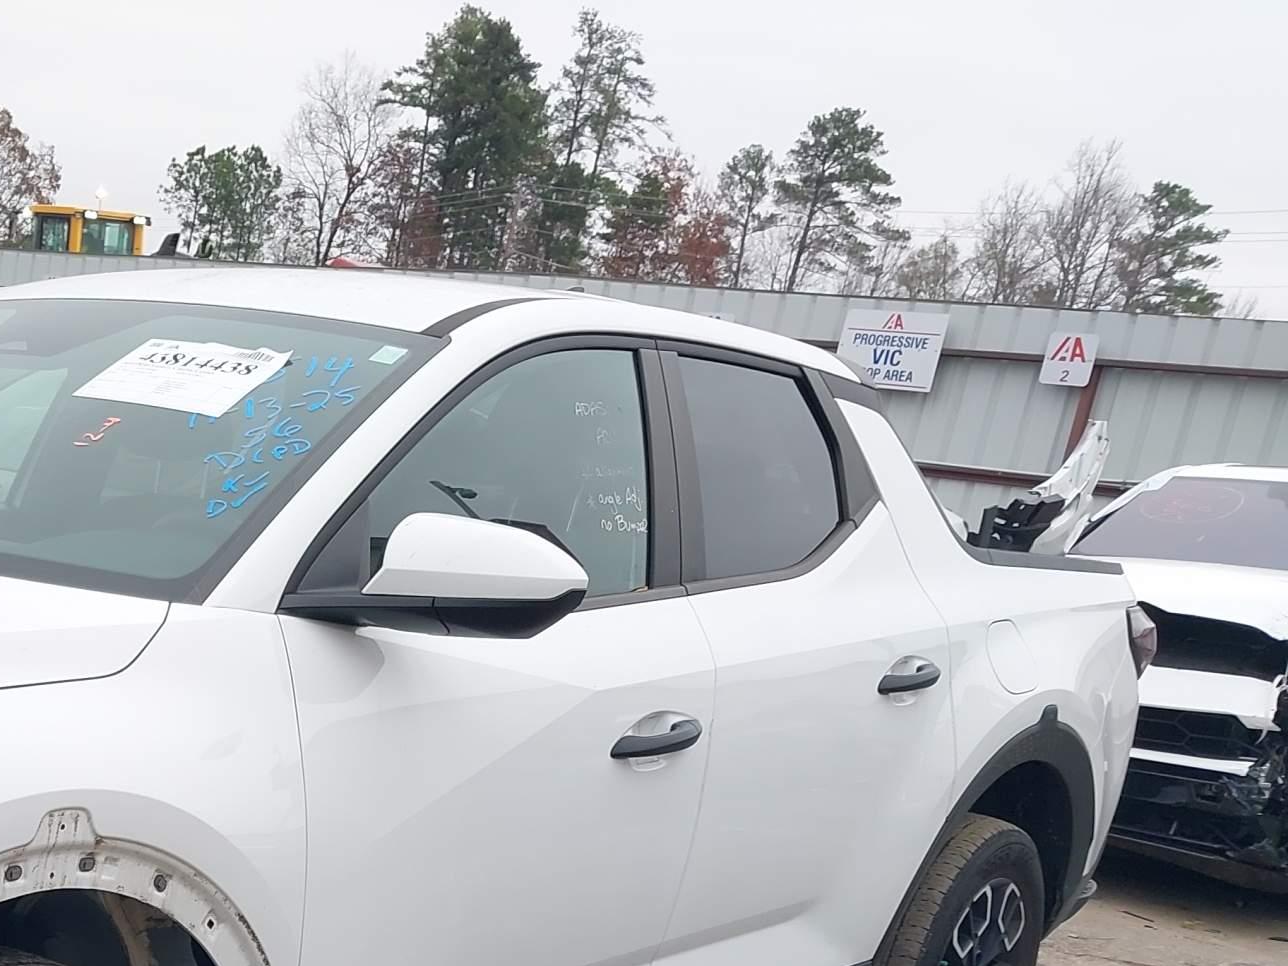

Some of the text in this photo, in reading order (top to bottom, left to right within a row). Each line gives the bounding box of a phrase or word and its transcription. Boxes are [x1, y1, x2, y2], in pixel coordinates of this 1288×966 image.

[852, 333, 929, 349] PROGRESSIVE
[873, 349, 902, 367] VIC
[883, 369, 912, 382] AREA
[1059, 369, 1070, 382] 2
